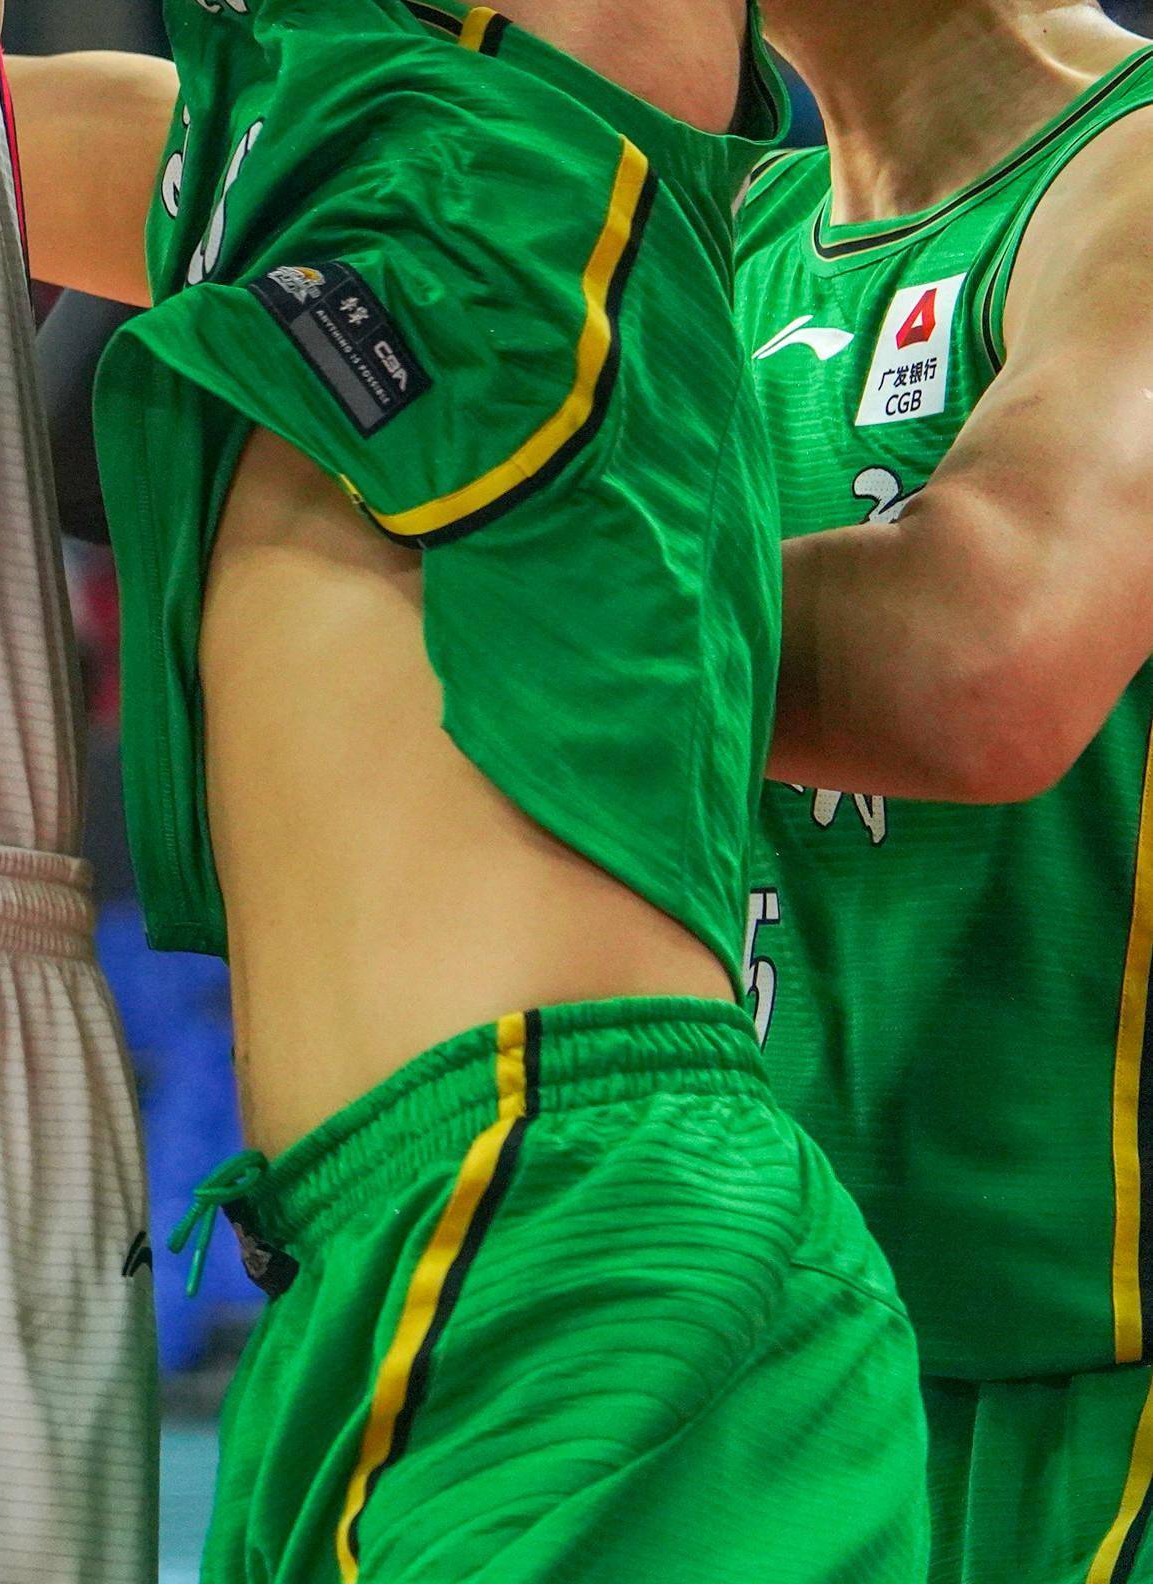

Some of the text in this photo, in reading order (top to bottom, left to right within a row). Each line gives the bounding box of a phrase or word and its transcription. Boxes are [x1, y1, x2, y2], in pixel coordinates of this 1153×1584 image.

[373, 340, 408, 392] CBA
[878, 357, 938, 391] 广发银行
[885, 390, 923, 416] CGB
